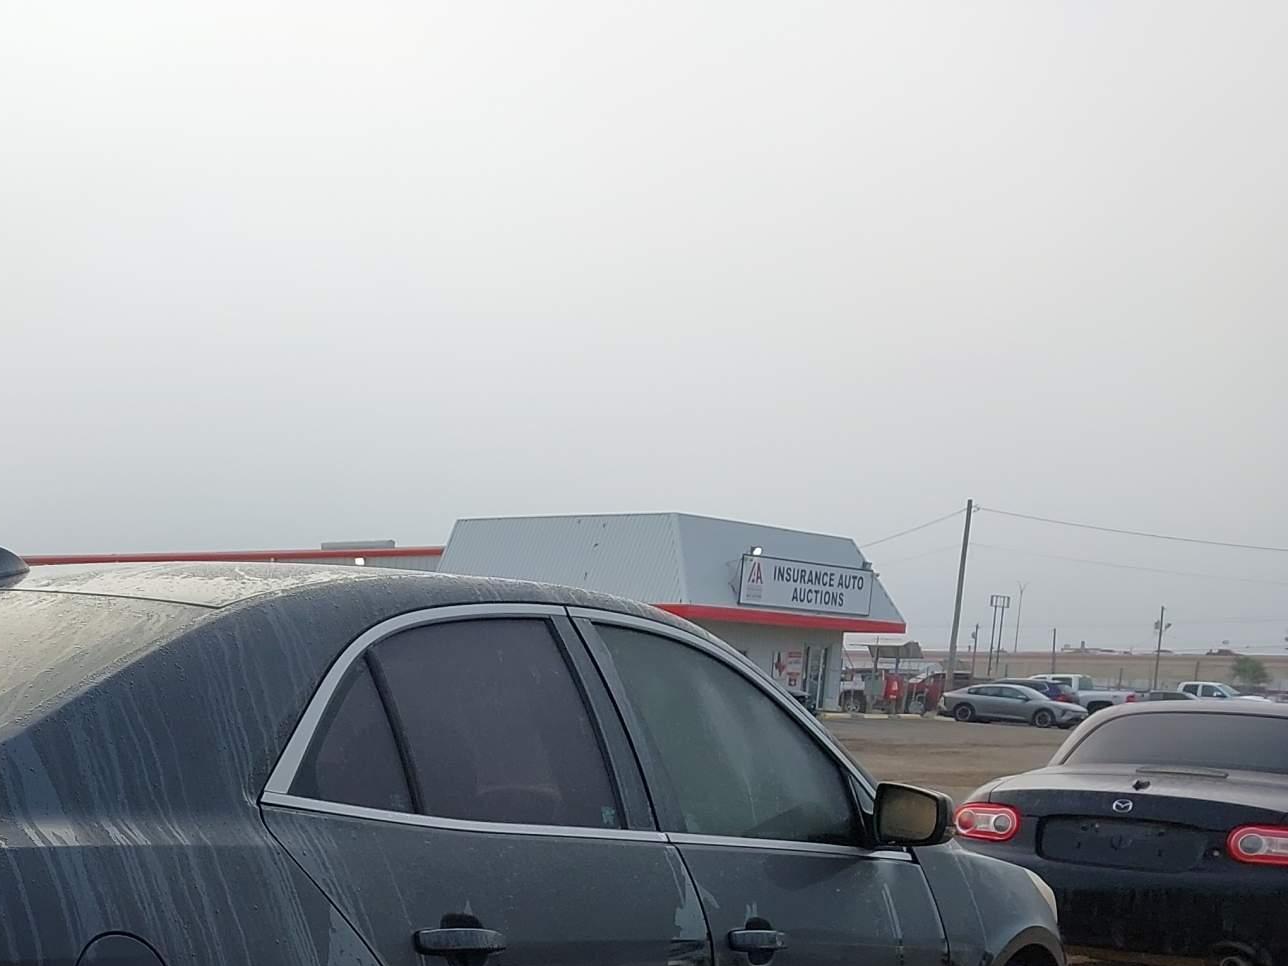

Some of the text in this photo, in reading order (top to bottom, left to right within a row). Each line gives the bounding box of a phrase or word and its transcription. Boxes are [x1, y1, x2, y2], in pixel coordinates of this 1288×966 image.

[773, 566, 864, 591] INSURANCE AUTO
[791, 587, 845, 608] AUCTIONS
